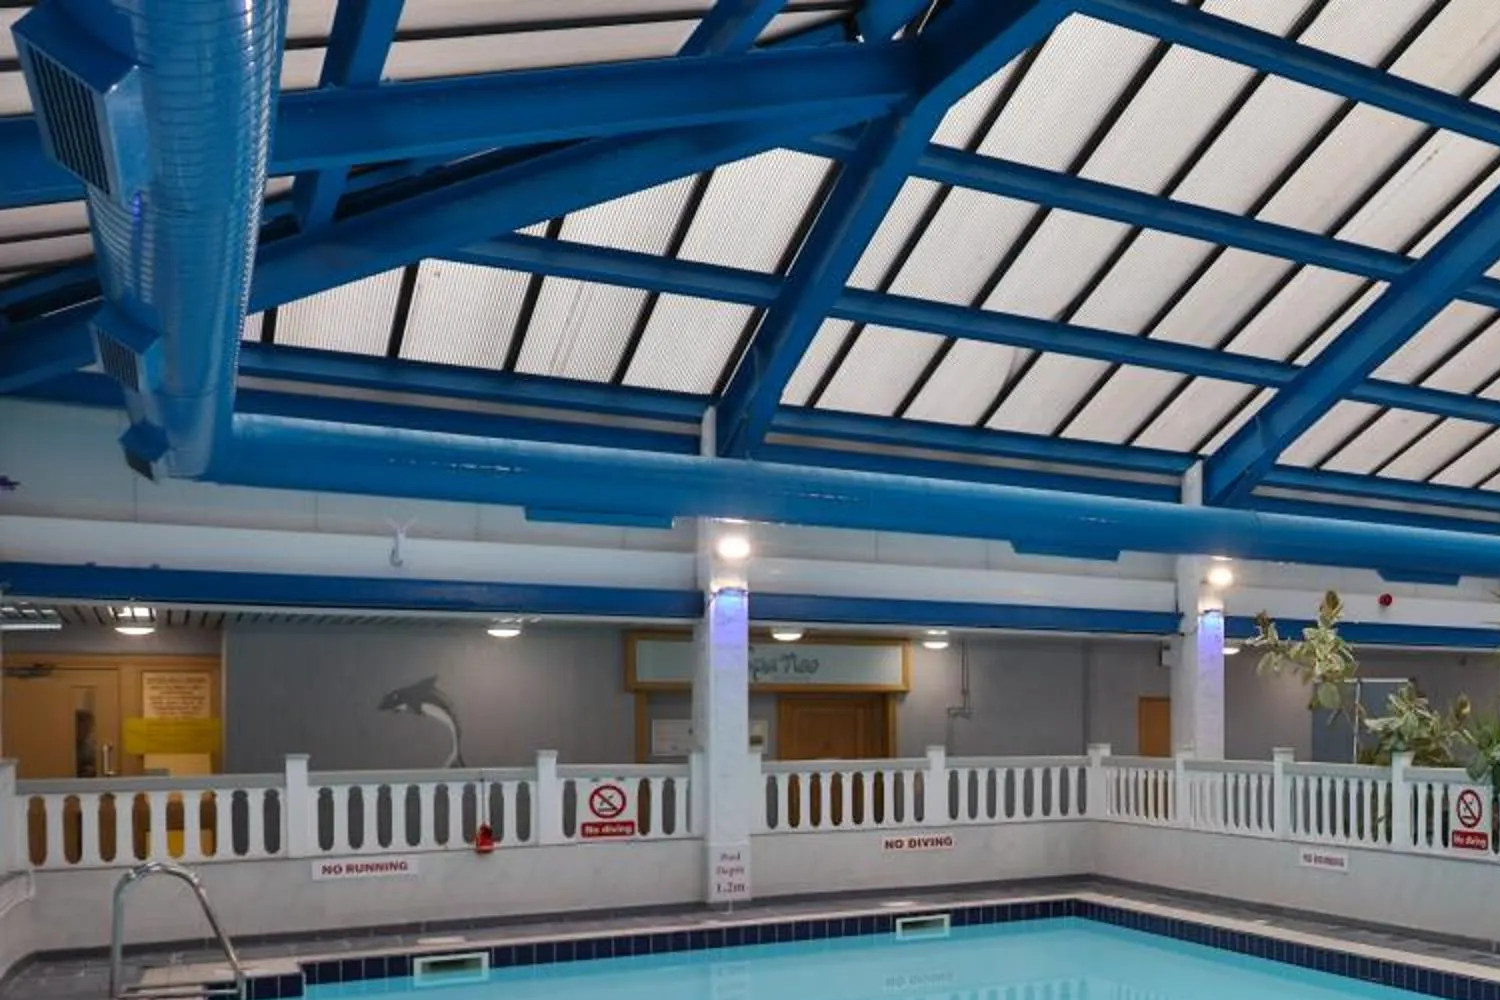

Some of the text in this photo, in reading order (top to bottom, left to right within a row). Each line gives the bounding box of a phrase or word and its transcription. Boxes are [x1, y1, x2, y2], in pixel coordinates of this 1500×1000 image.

[885, 836, 953, 849] NO DIVING
[321, 861, 408, 875] NO RUNNING
[717, 882, 745, 893] 1.2m
